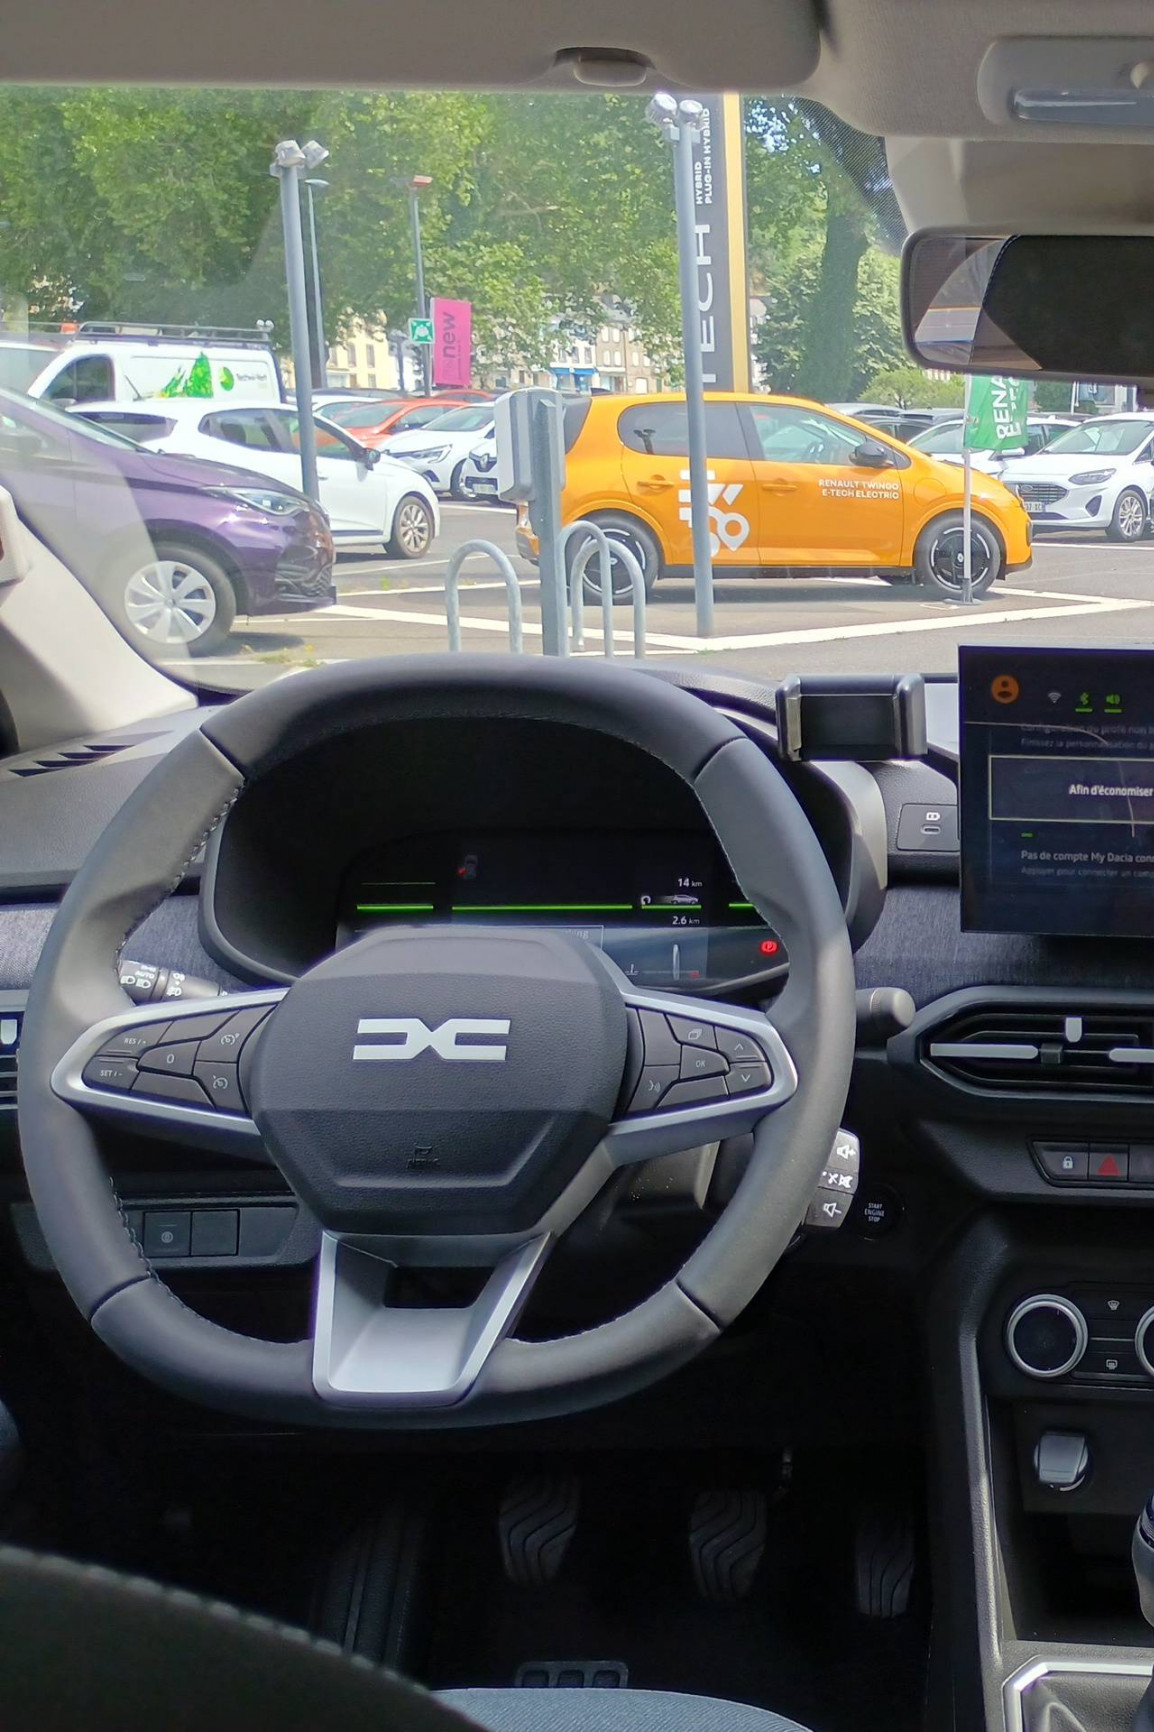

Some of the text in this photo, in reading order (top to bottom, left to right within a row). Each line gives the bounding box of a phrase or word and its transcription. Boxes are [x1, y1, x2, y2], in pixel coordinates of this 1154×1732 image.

[702, 108, 712, 204] PLUG-IN HYBRID
[695, 161, 703, 205] HYBRID
[819, 479, 899, 490] RENAULT TWINGO
[822, 489, 899, 499] E-TECH ELECTRIC
[1069, 784, 1089, 795] Afin
[1090, 785, 1153, 796] d'économiser
[1021, 850, 1038, 860] Pas
[1039, 851, 1051, 860] de
[1053, 852, 1089, 863] compte
[1091, 852, 1105, 864] My
[1107, 853, 1133, 863] Dacia
[677, 878, 690, 887] 14
[672, 916, 688, 925] 2.6
[864, 1208, 885, 1217] ENGINE
